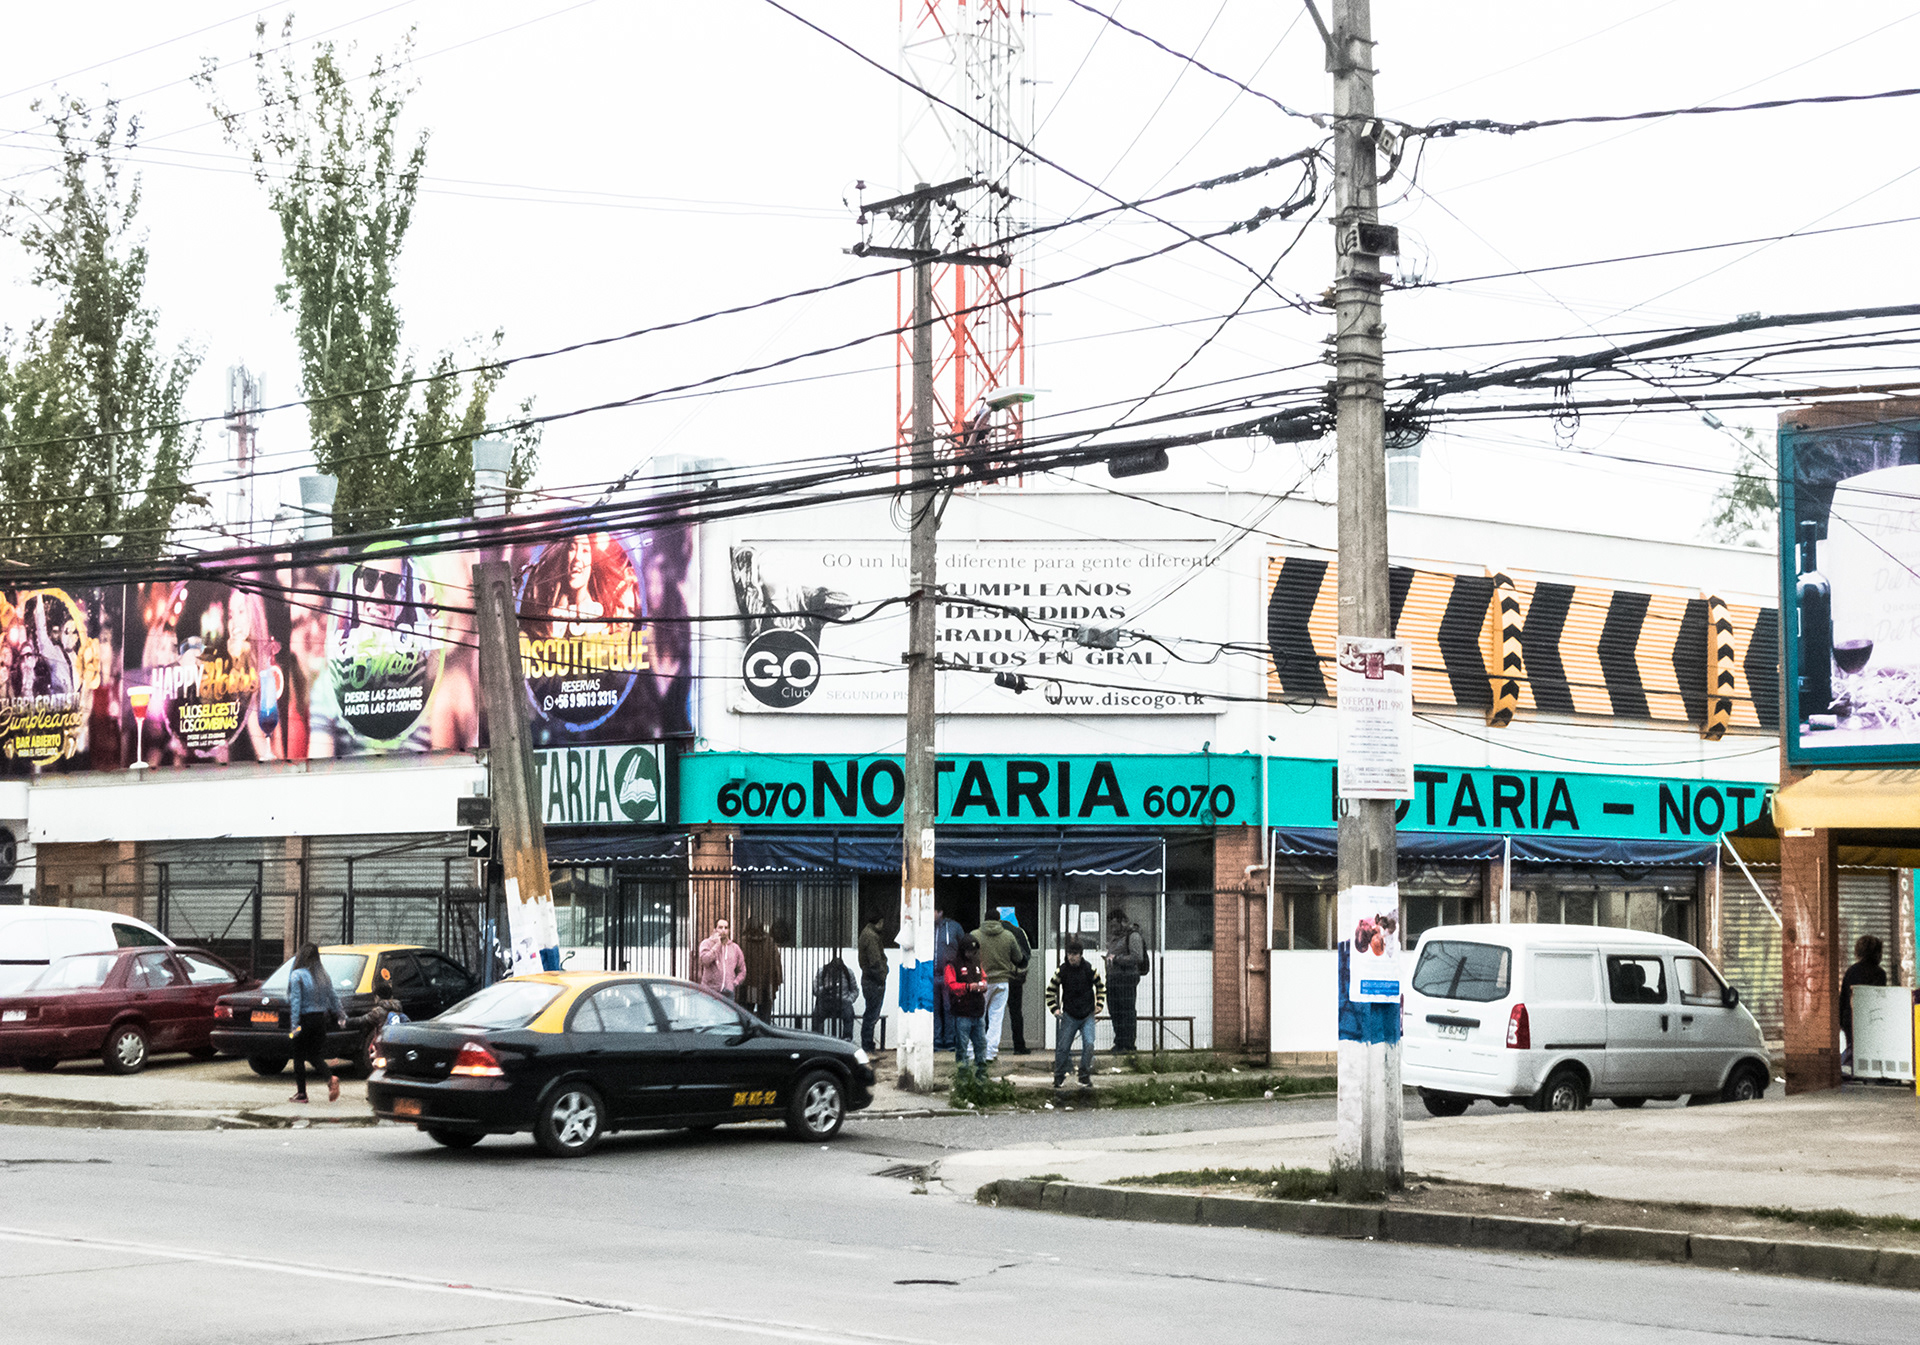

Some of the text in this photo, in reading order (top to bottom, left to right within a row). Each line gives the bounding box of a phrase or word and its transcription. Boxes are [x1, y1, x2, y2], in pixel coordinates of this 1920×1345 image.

[822, 553, 852, 568] GO
[859, 557, 883, 568] un
[945, 554, 1026, 569] diferente
[1033, 556, 1076, 572] para
[1081, 556, 1133, 573] gente
[1138, 552, 1221, 568] diferente
[942, 580, 1132, 597] CUMPLEAÑOS
[944, 605, 1126, 620] DESPEDIDAS
[1038, 652, 1073, 666] EN
[1085, 652, 1168, 666] GRAL.
[745, 651, 819, 688] GO
[152, 664, 205, 700] HAPPY
[561, 679, 601, 692] RESERVAS
[344, 691, 370, 703] DESDE
[371, 689, 387, 702] LAS
[781, 686, 811, 698] Club
[826, 690, 889, 701] SEGUNDO
[555, 693, 569, 709] +56
[569, 693, 575, 708] 9
[1047, 691, 1205, 709] www.discogo.tk
[344, 703, 370, 716] HASTA
[371, 702, 386, 714] LAS
[15, 736, 31, 749] BAR
[717, 781, 807, 817] 6070
[1142, 784, 1235, 819] 6070
